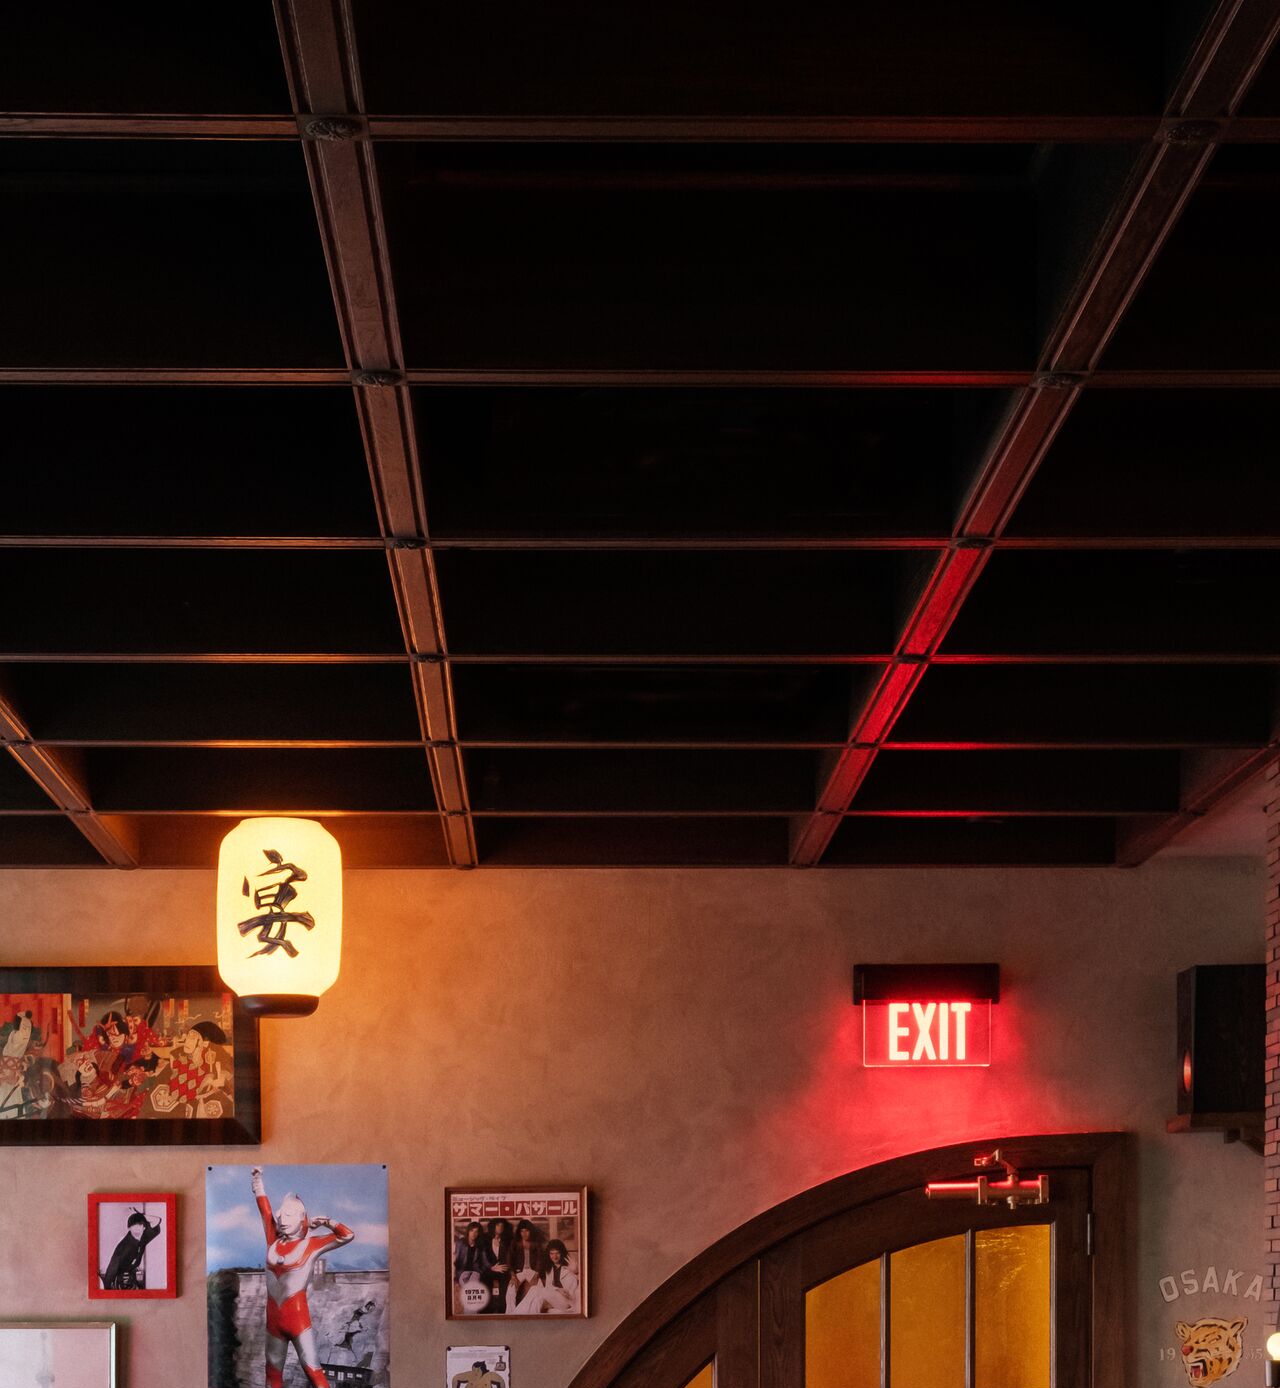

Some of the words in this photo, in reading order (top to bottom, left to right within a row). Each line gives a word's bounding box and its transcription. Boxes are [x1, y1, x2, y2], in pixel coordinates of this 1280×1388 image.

[237, 849, 316, 959] 宴
[888, 1002, 971, 1061] EXIT
[453, 1201, 578, 1216] サマー・バザール
[1158, 1266, 1264, 1303] OSAKA
